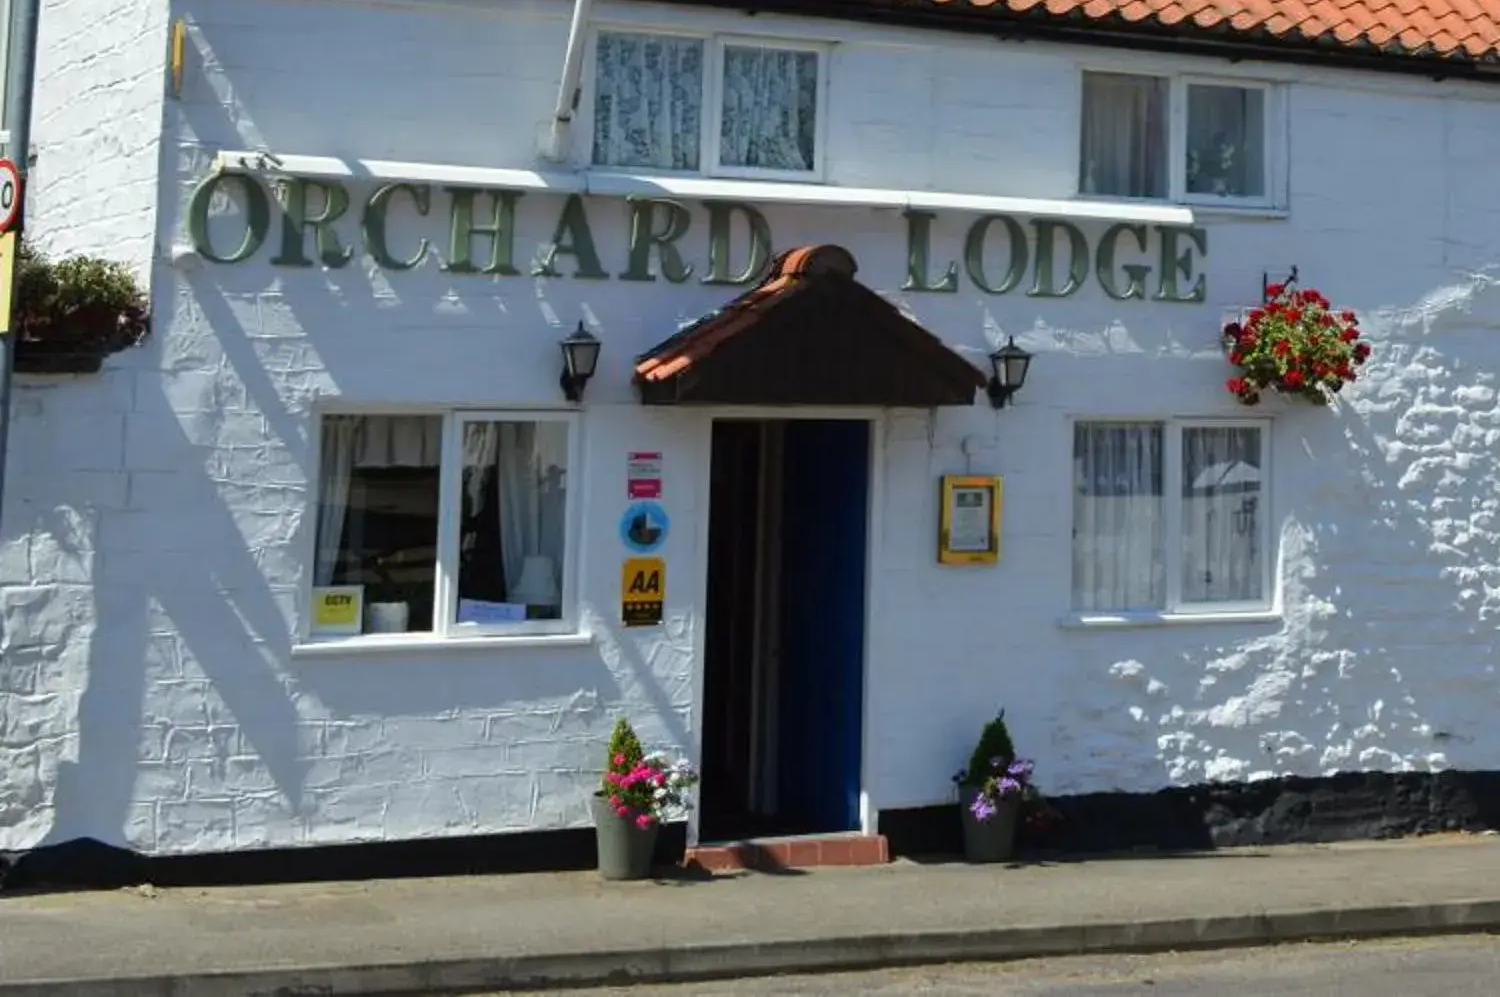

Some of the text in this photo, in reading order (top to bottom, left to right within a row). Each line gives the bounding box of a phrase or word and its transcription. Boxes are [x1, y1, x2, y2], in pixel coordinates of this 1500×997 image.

[185, 173, 1207, 303] ORCHARD LODGE
[629, 570, 659, 594] AA
